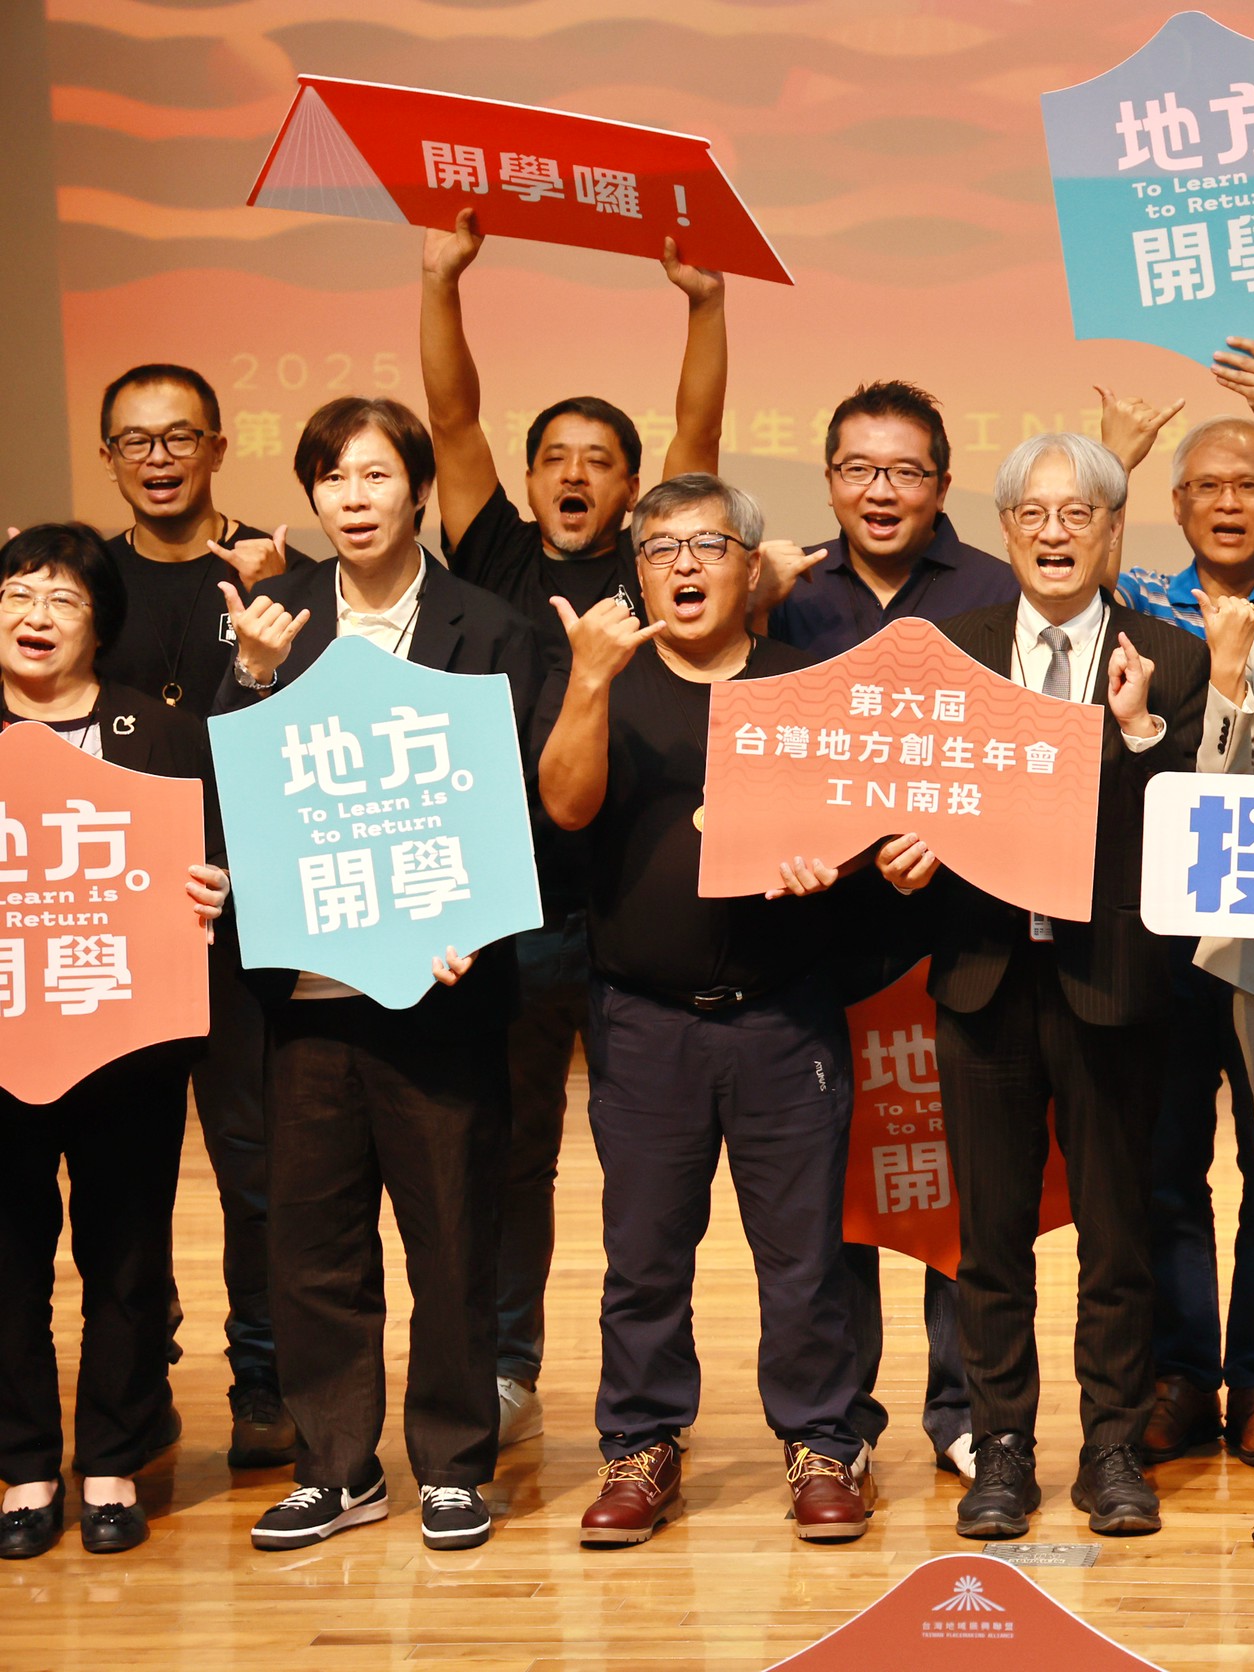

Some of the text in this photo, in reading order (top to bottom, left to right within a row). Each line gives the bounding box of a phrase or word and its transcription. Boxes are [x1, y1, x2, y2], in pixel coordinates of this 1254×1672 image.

[1132, 182, 1161, 198] To
[1173, 171, 1248, 193] Learn
[1145, 204, 1175, 218] to
[232, 353, 400, 391] 2025
[849, 684, 966, 722] 第六屆
[735, 722, 1058, 775] 台灣地方創生年會
[298, 790, 447, 824] To Learn is
[311, 814, 442, 844] to Return
[89, 886, 118, 902] is
[298, 836, 471, 935] 開學
[6, 911, 108, 928] Return
[875, 1103, 903, 1116] To
[887, 1122, 916, 1135] to
